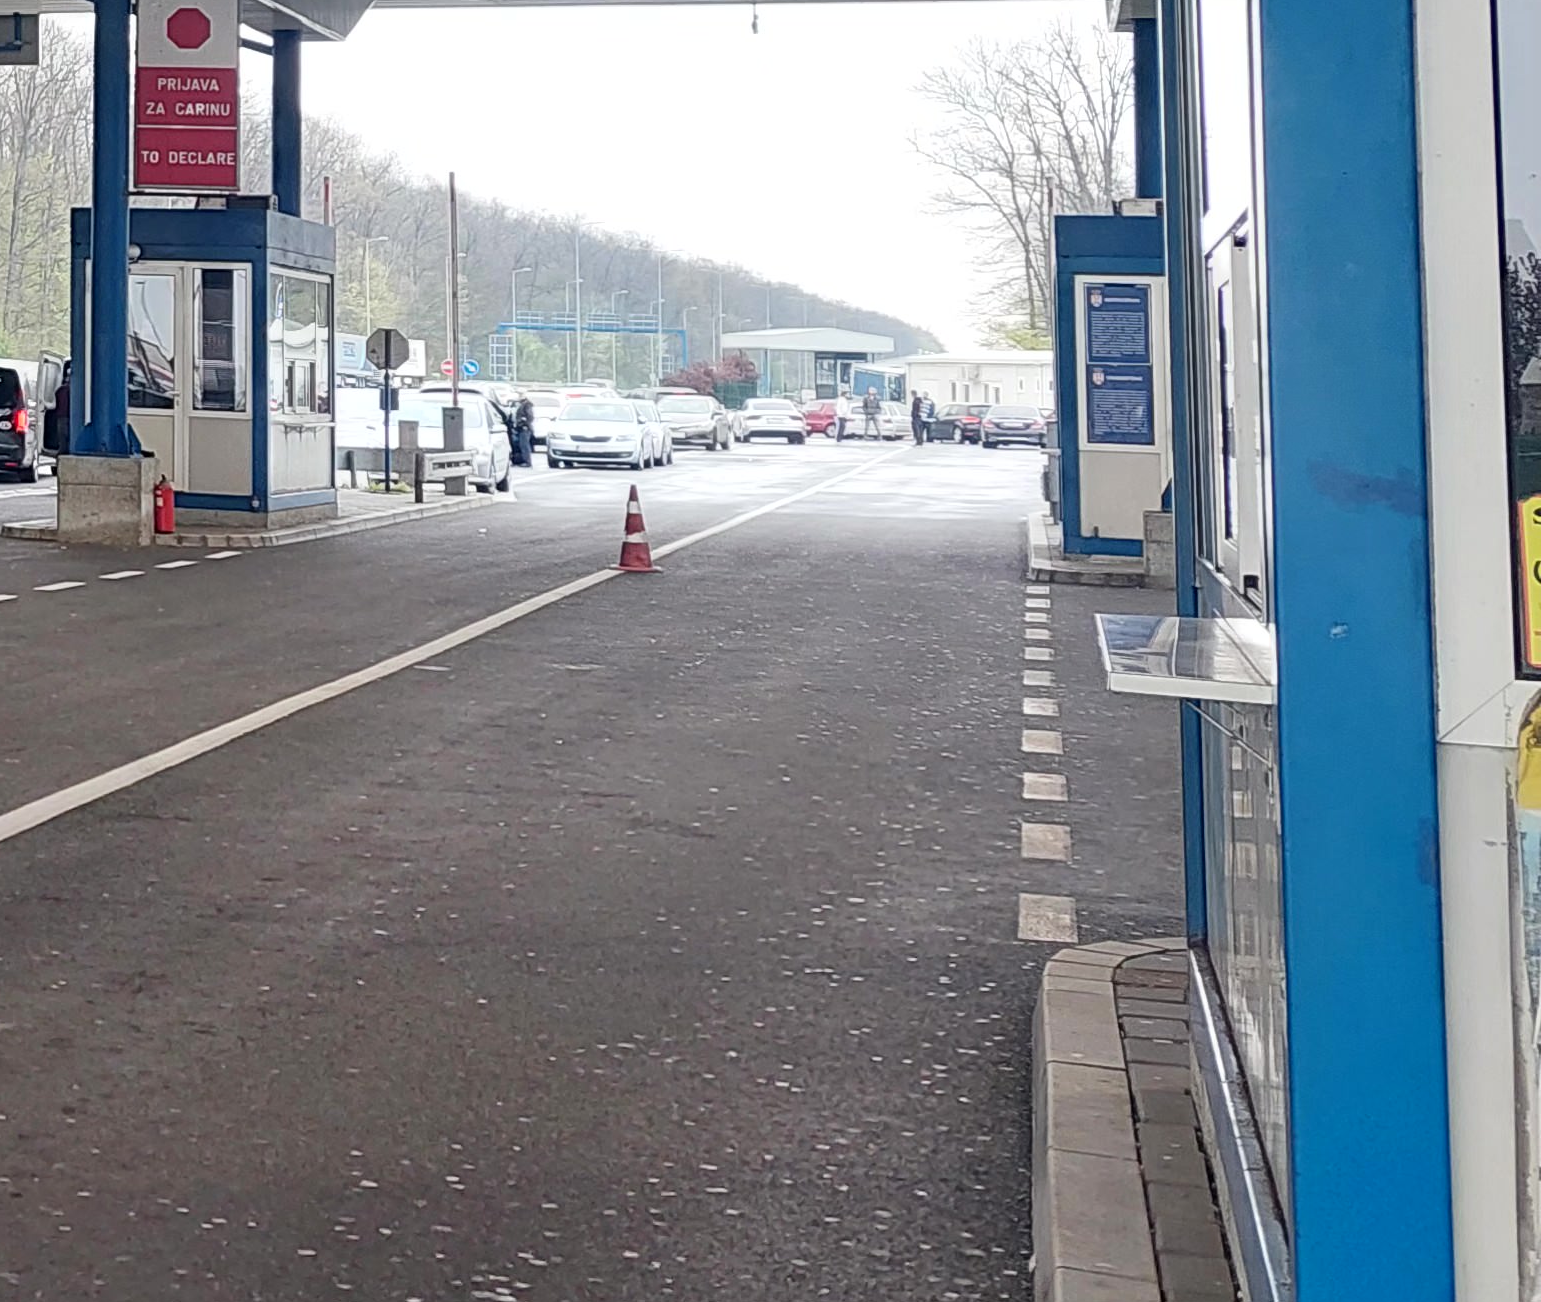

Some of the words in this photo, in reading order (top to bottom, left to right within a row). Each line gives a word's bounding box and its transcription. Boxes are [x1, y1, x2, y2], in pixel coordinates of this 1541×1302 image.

[156, 77, 220, 92] PRIJAVA
[145, 101, 166, 116] ZA
[175, 102, 231, 117] CARINU
[140, 150, 160, 164] TO
[168, 150, 236, 166] DECLARE
